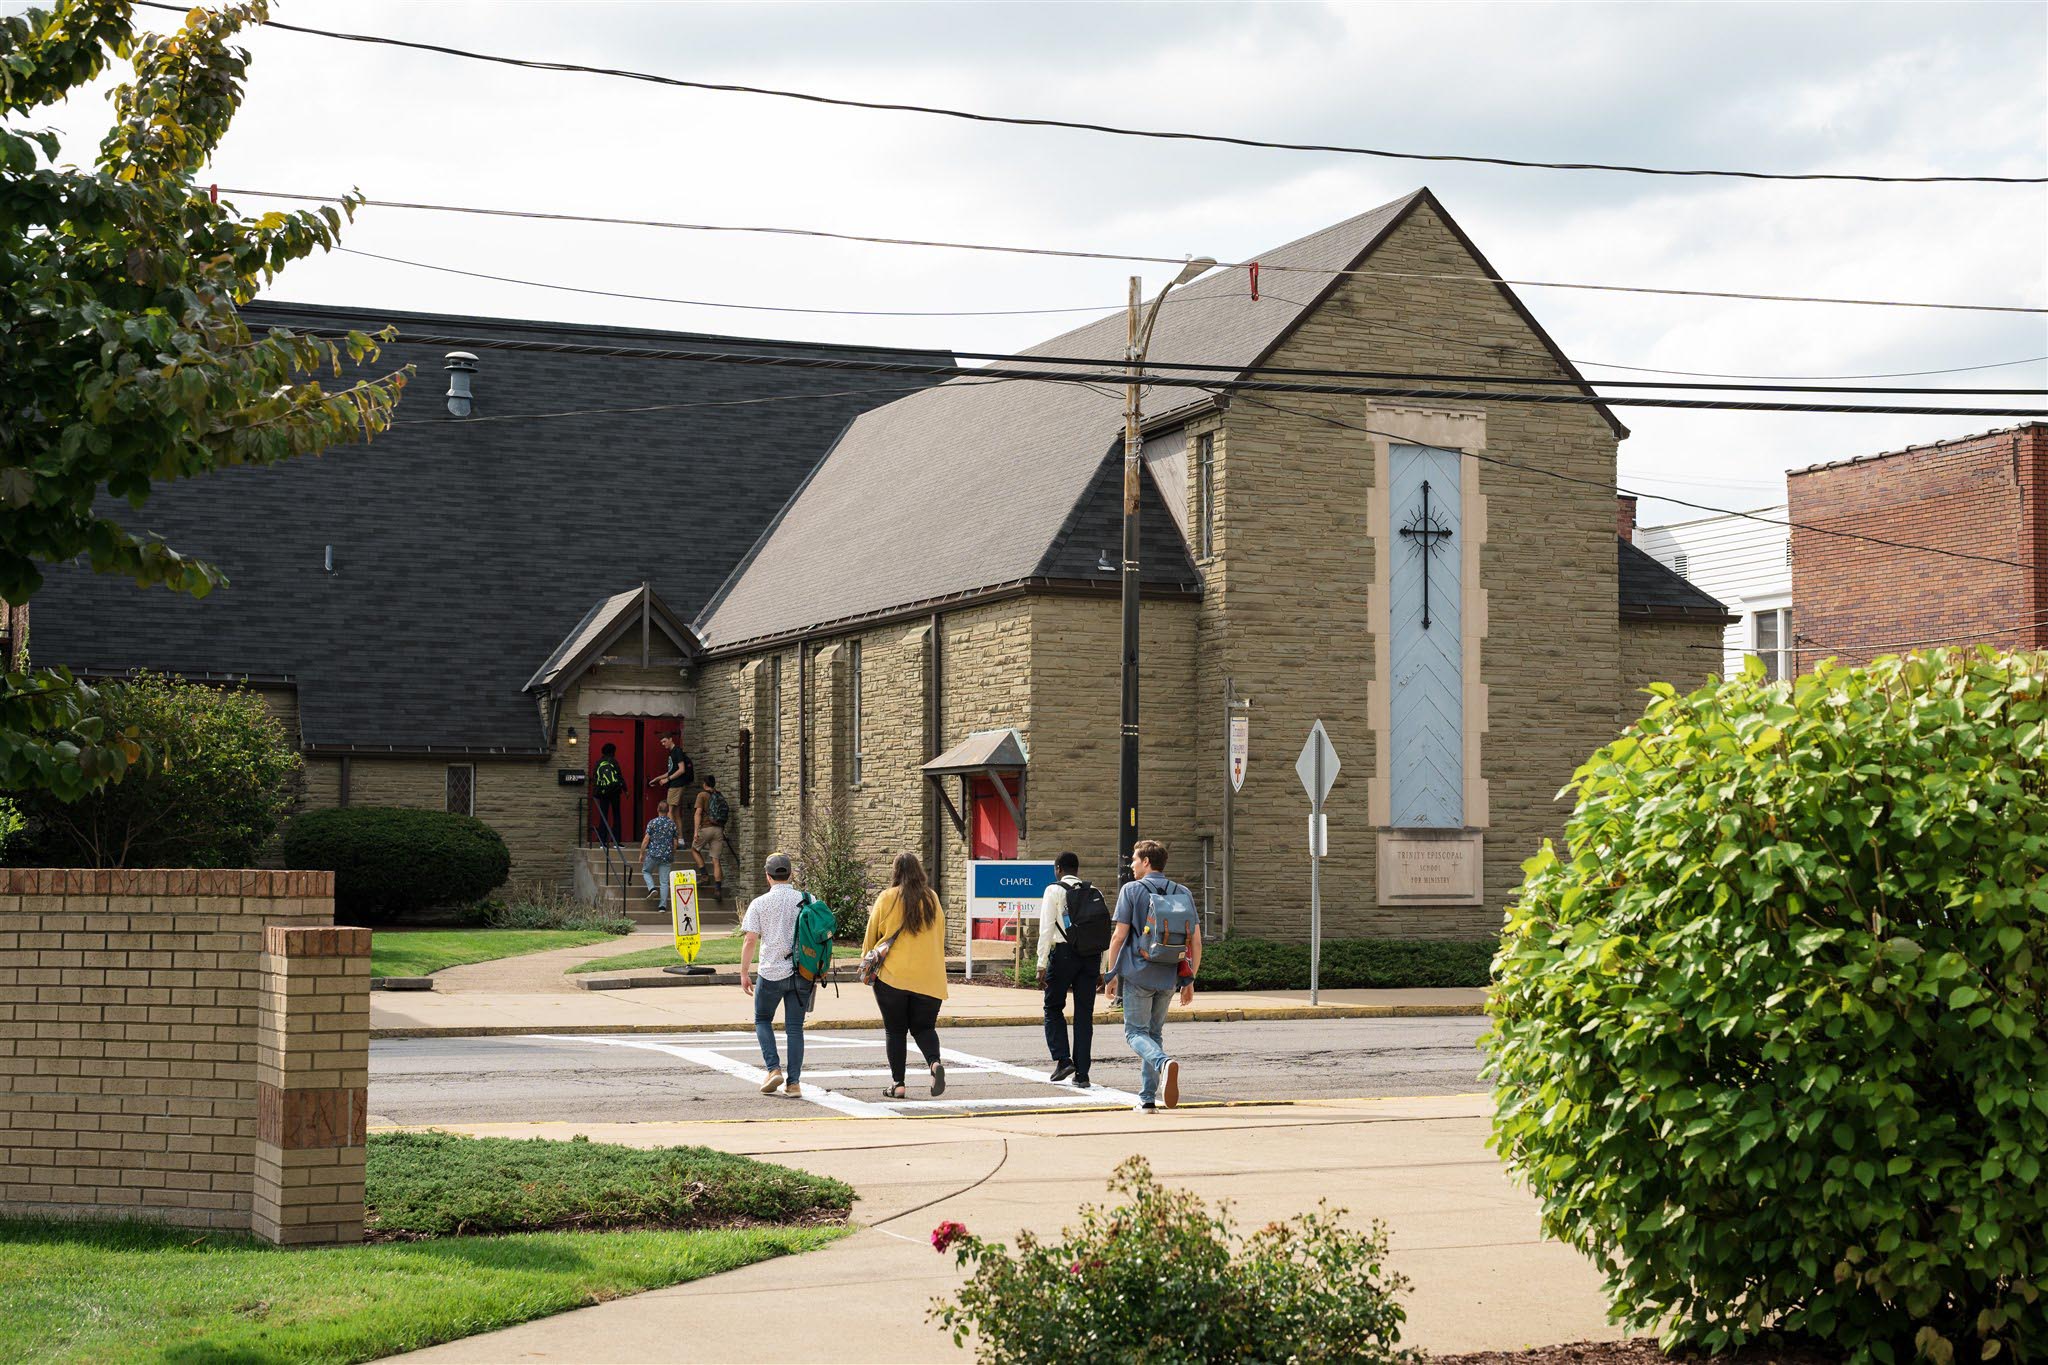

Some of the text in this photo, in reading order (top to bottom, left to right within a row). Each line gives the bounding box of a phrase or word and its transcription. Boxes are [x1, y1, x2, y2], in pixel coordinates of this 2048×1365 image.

[1397, 851, 1463, 860] TRINITY EPISCOPAL
[1420, 864, 1441, 872] SCHOOL
[999, 877, 1033, 886] CHAPEL
[1411, 876, 1450, 884] FOR MINISTRY
[1007, 902, 1036, 912] Trnity
